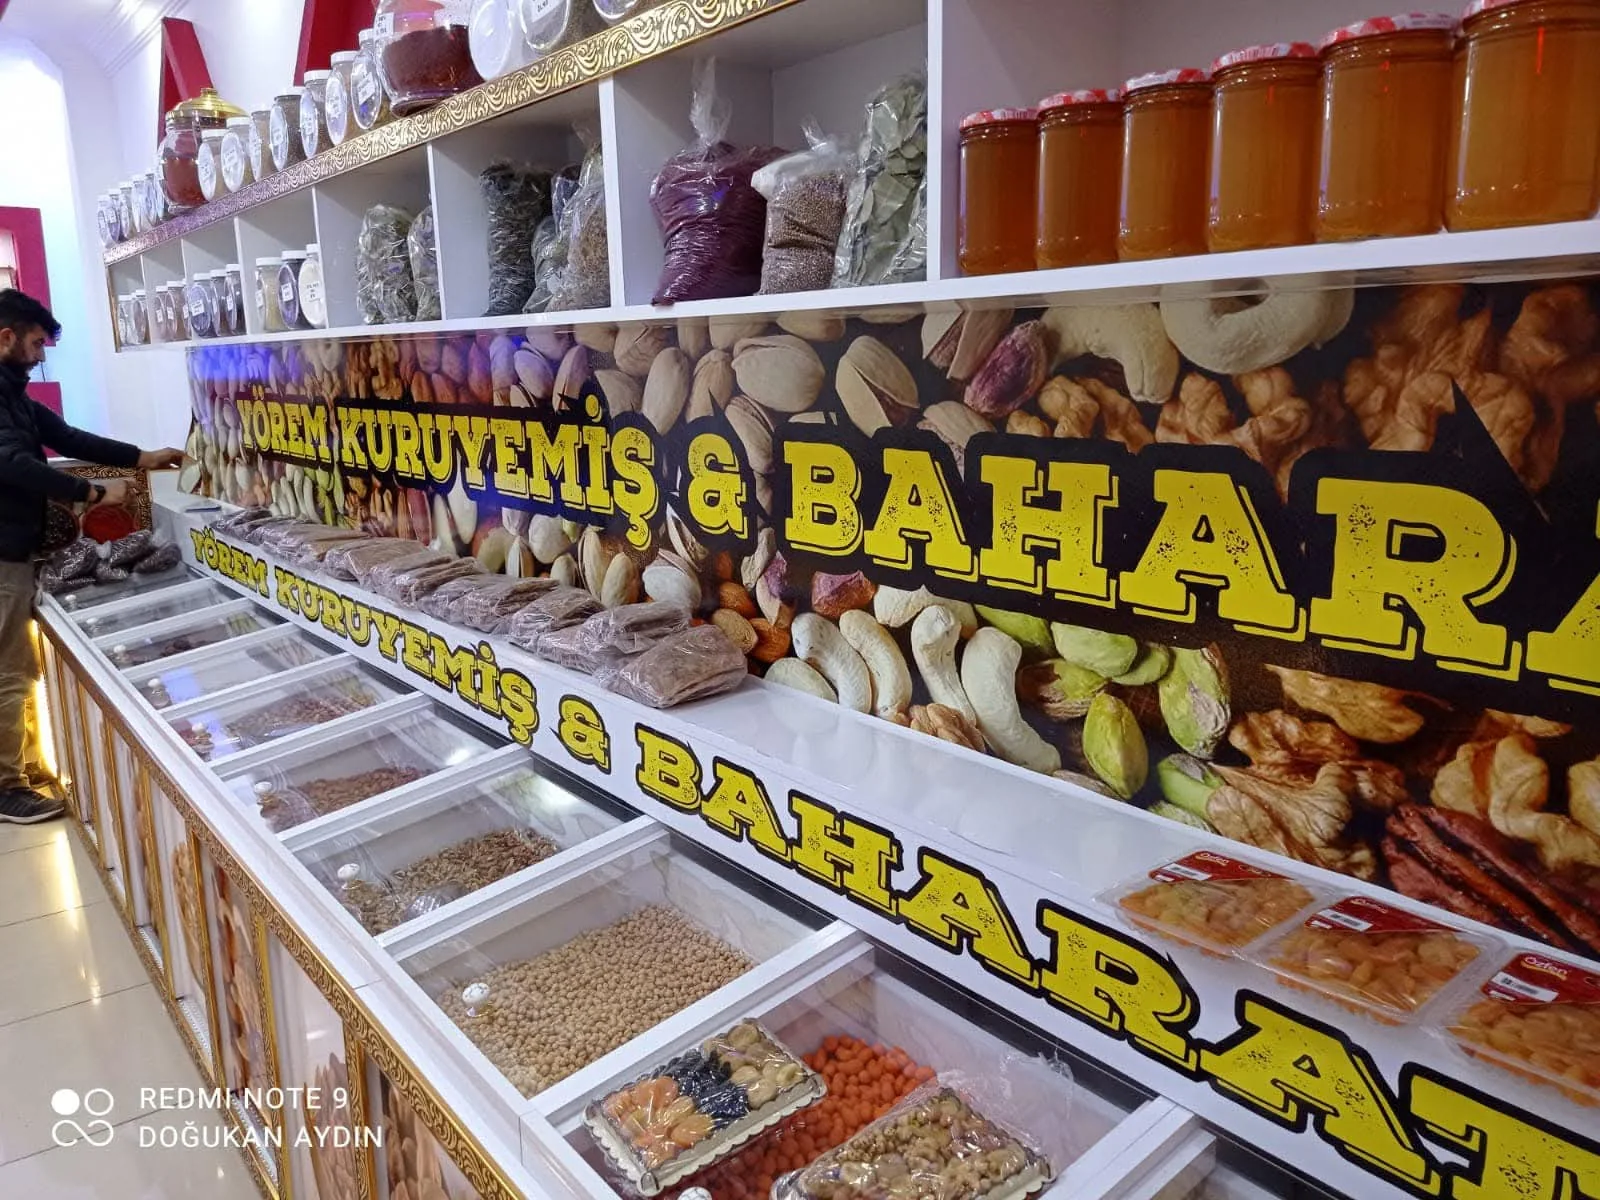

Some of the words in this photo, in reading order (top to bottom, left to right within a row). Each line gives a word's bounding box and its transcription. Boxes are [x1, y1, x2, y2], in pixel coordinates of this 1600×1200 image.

[236, 384, 332, 464] YÖREM
[337, 394, 658, 551] KURUYEMİŞ
[687, 433, 746, 538] &
[189, 526, 270, 599] YÖREM
[274, 565, 539, 747] KURUYEMİŞ
[560, 697, 609, 772] &
